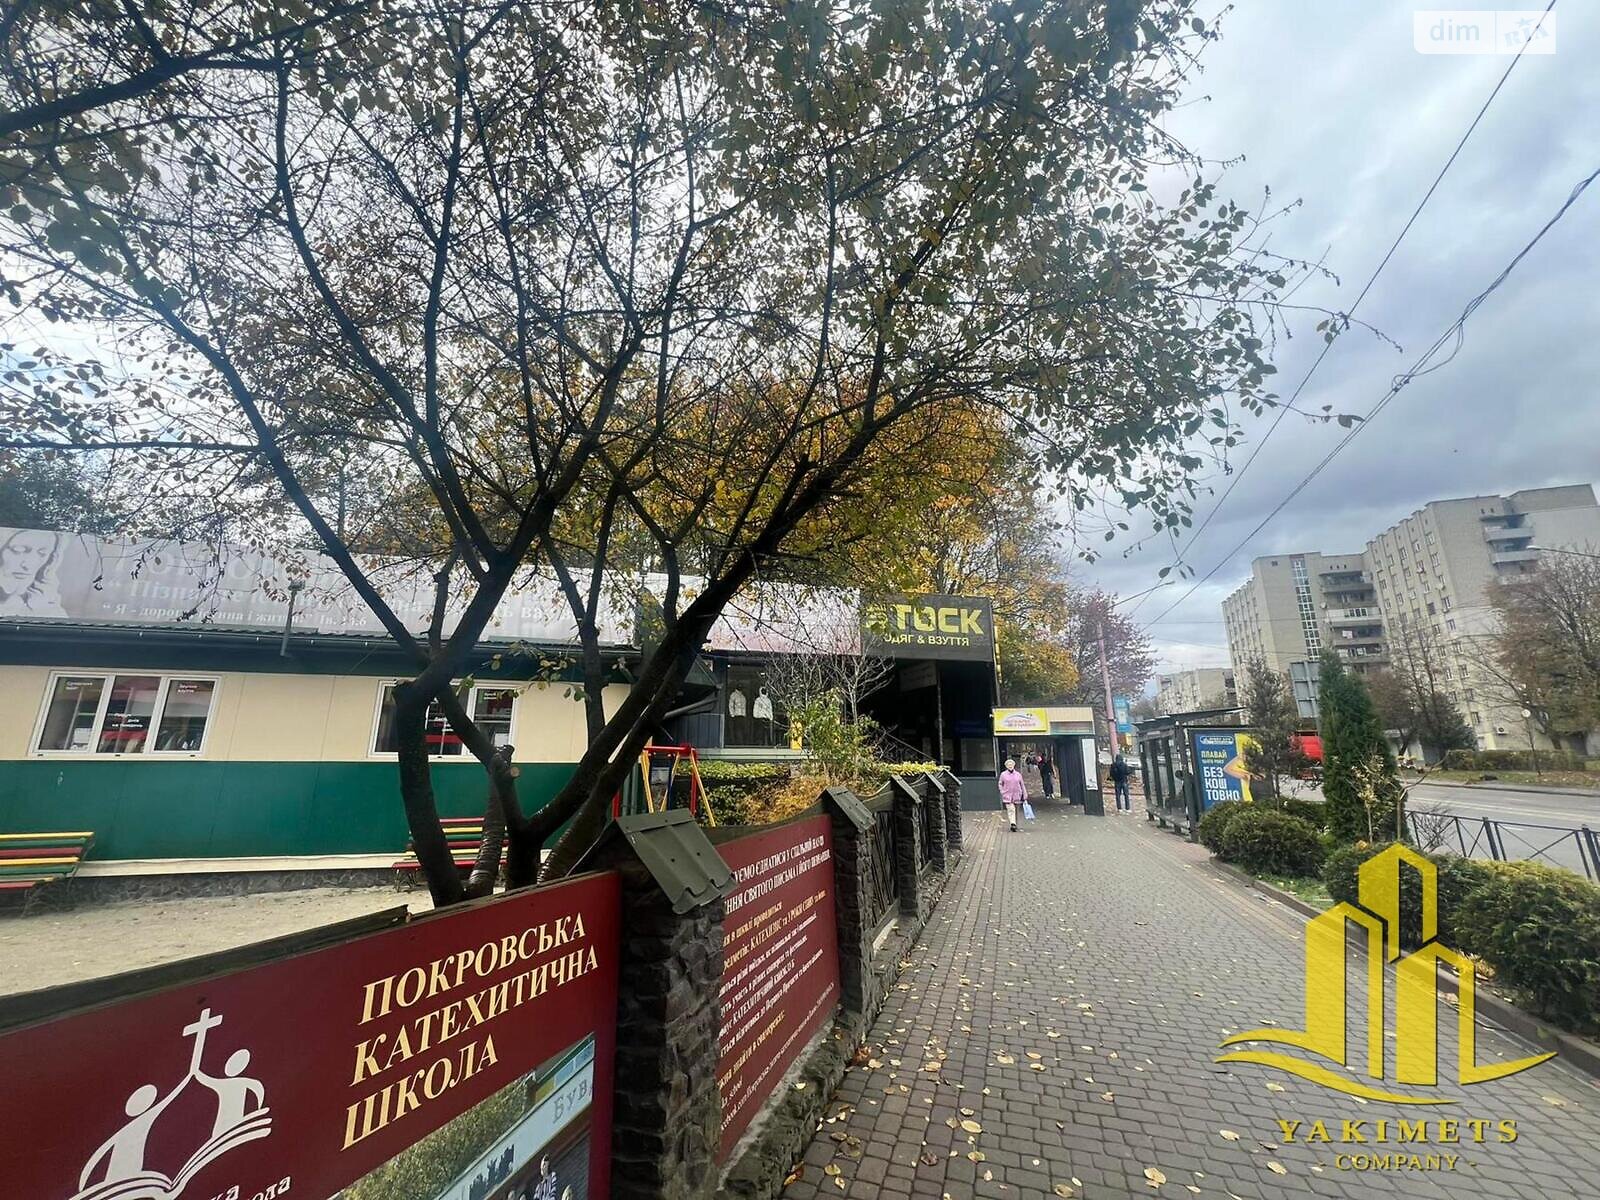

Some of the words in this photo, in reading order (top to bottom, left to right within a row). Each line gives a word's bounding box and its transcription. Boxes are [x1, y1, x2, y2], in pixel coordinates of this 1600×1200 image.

[917, 636, 926, 645] &
[928, 636, 970, 647] ВЗУТТЯ
[1203, 766, 1224, 778] БЕЗ
[1205, 778, 1227, 789] КОШ
[1206, 789, 1240, 801] ТОВНО
[744, 877, 774, 905] СВЯТОГО
[357, 912, 586, 1026] ПОКРОВСЬКА
[350, 945, 598, 1087] КАТЕХИТИЧНА
[340, 1034, 498, 1151] ШКОЛА
